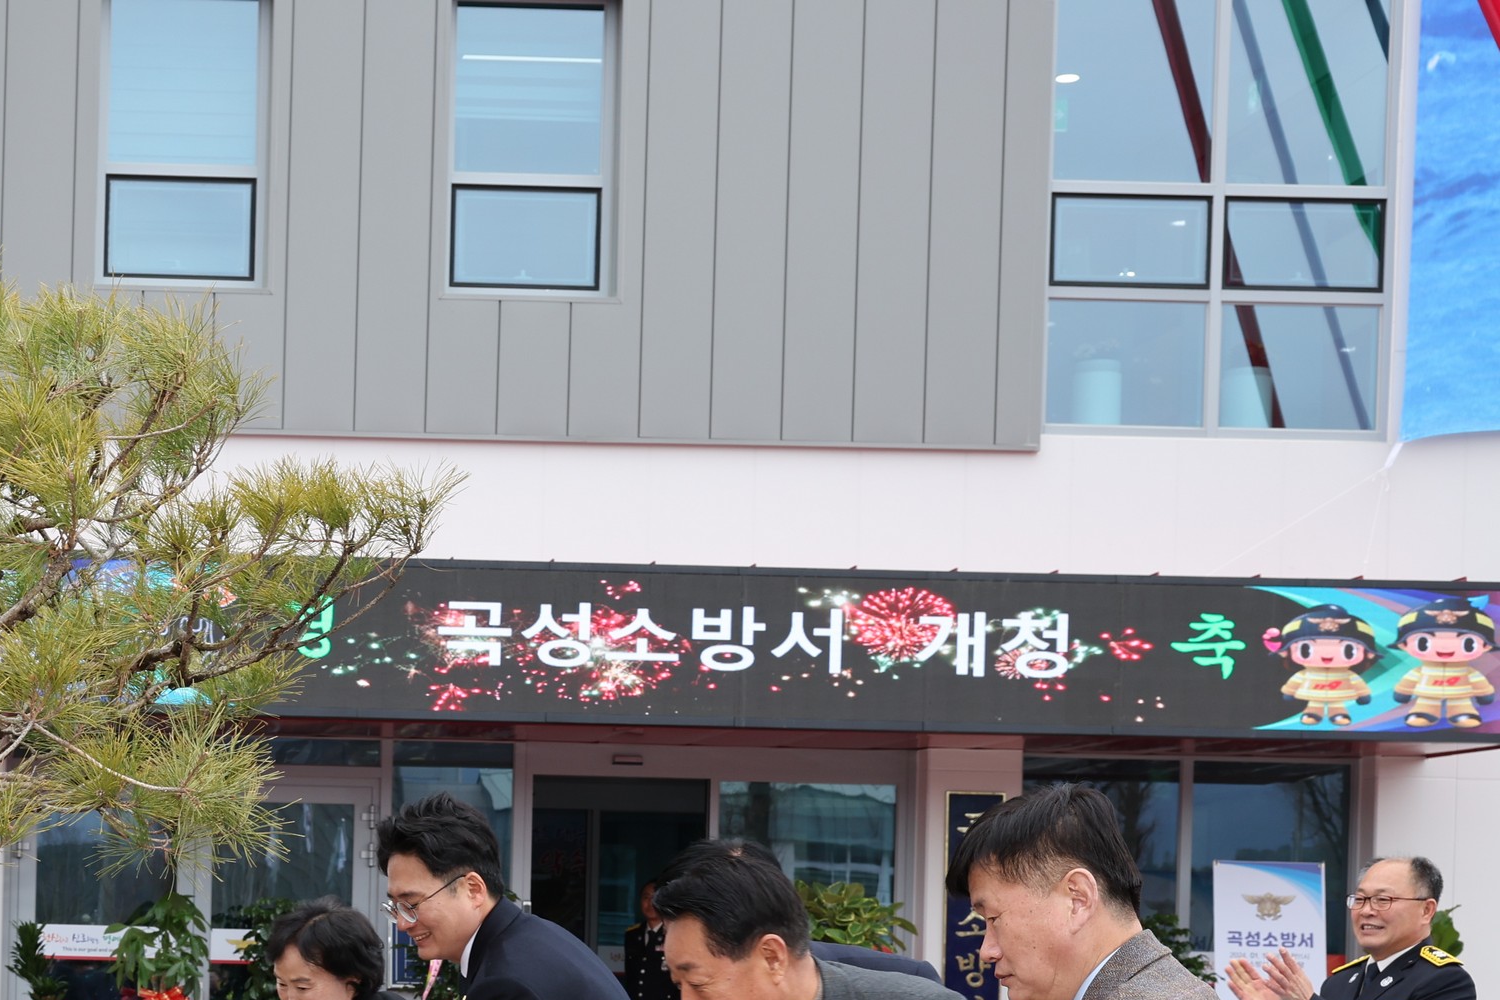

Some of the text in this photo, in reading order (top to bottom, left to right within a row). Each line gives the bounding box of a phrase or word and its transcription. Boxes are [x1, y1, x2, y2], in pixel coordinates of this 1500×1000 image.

[437, 600, 843, 674] 곡성소방서
[918, 610, 1070, 679] 개청
[1171, 612, 1246, 680] 축
[1227, 930, 1314, 948] 곡성소방서
